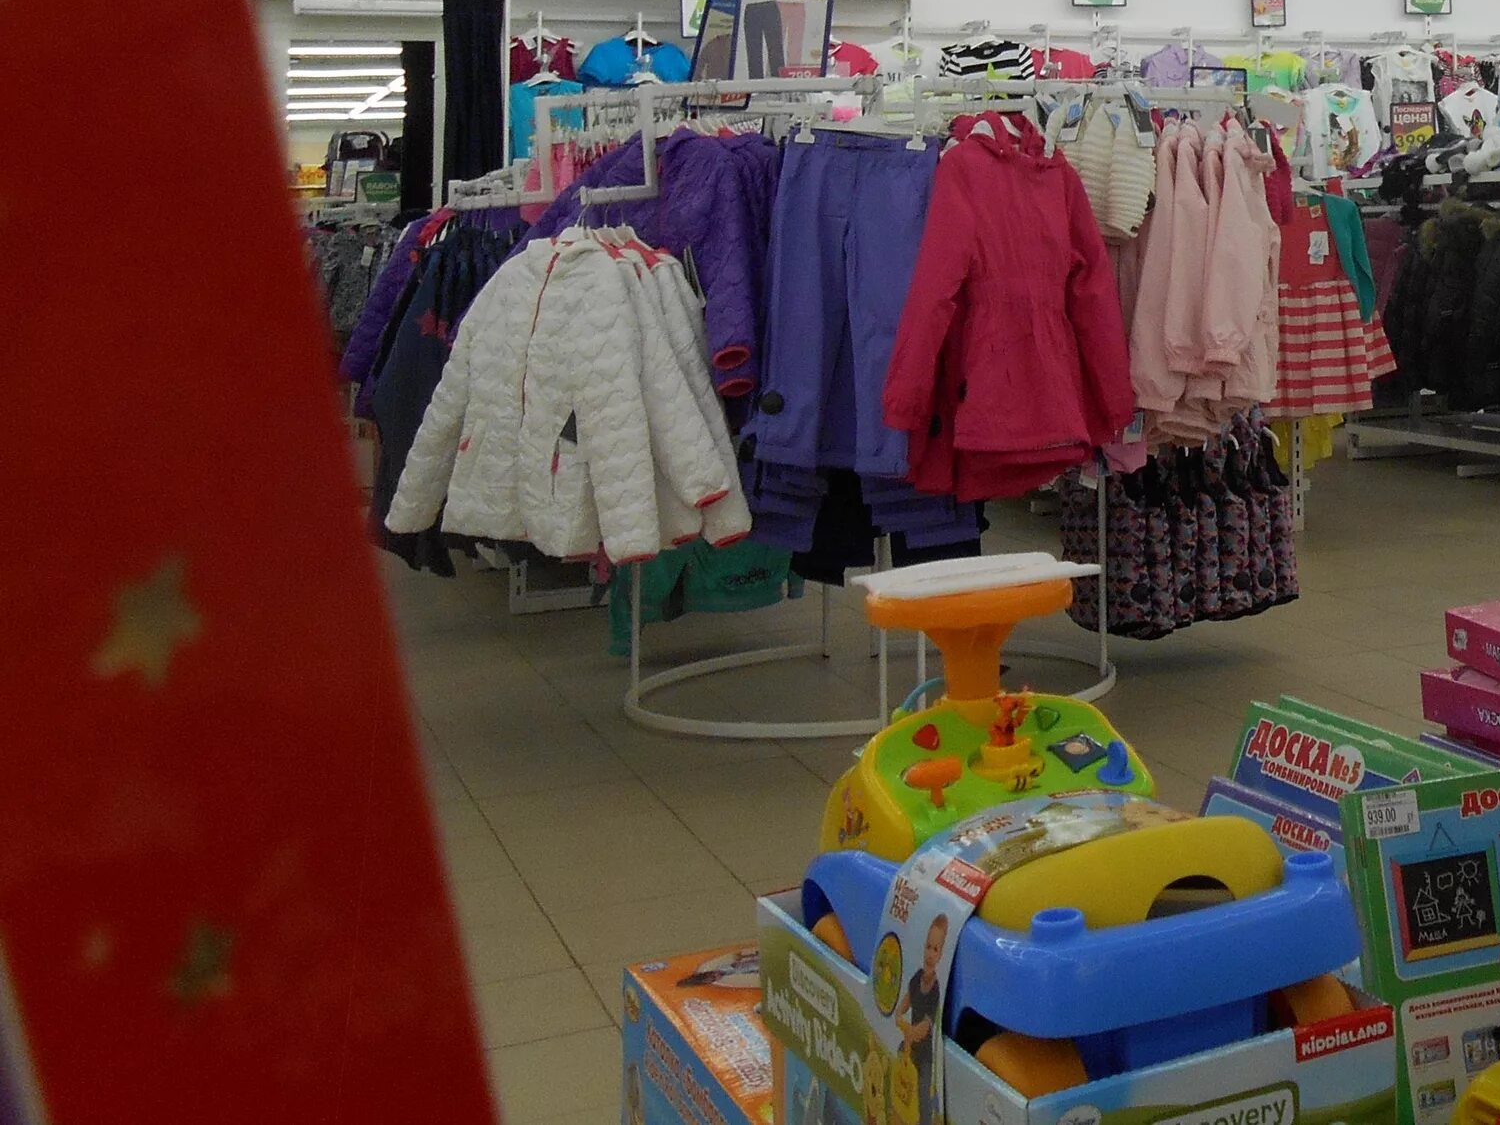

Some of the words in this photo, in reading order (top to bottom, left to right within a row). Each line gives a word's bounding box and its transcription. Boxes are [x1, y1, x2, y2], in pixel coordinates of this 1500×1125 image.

[1393, 112, 1432, 126] цена!
[1247, 720, 1331, 776] ДОСКА
[1329, 753, 1362, 784] №5
[1262, 759, 1345, 800] КОМБИНИРОВАНН
[1271, 815, 1314, 846] ДОСКА
